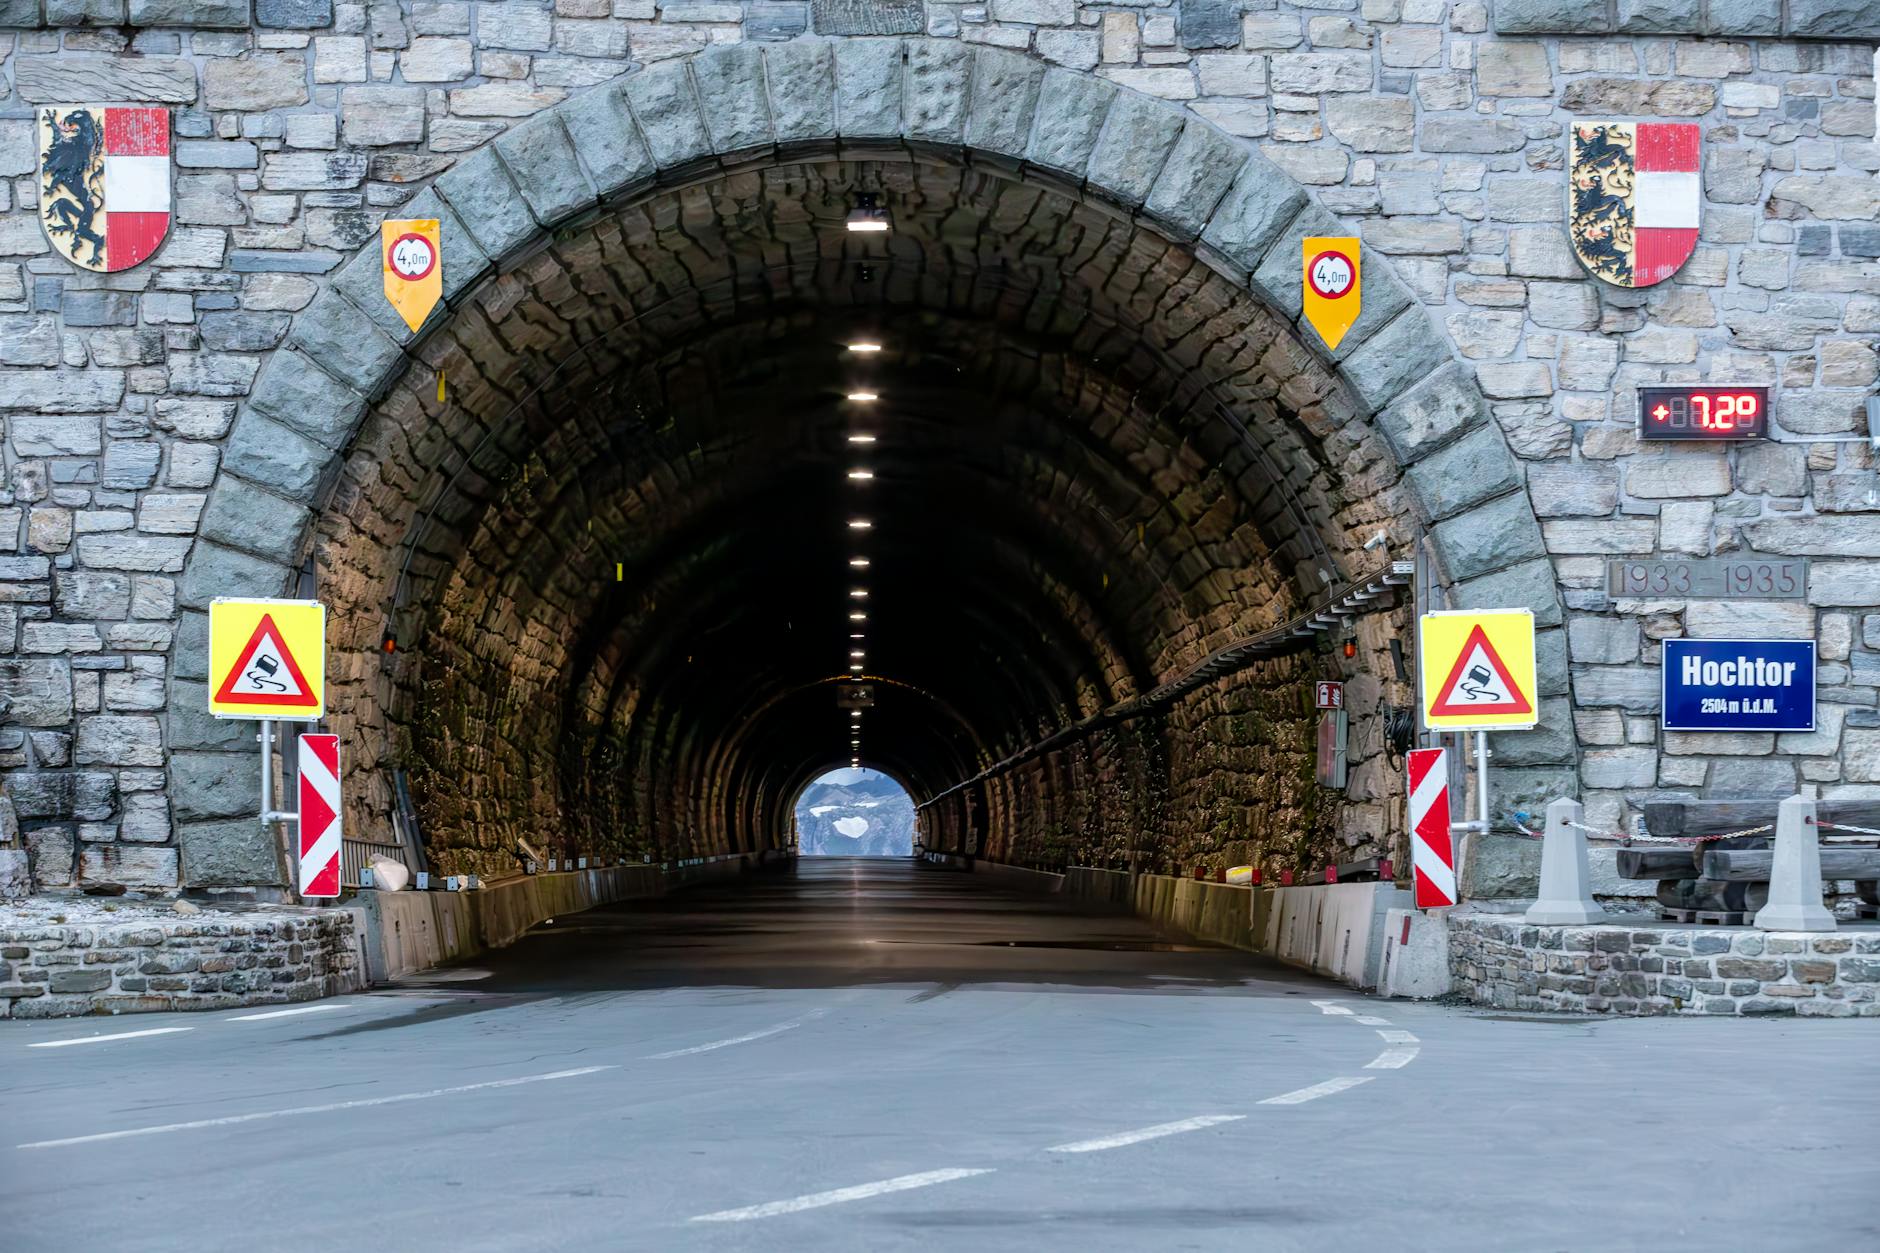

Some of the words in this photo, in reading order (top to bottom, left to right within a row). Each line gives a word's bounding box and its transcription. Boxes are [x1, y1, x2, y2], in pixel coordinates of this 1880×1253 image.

[1317, 264, 1347, 285] 4,0m
[1618, 564, 1692, 593] 1933
[1722, 564, 1796, 594] 1935
[1682, 655, 1796, 686] Hochtor
[1742, 698, 1778, 714] ü.d.M.
